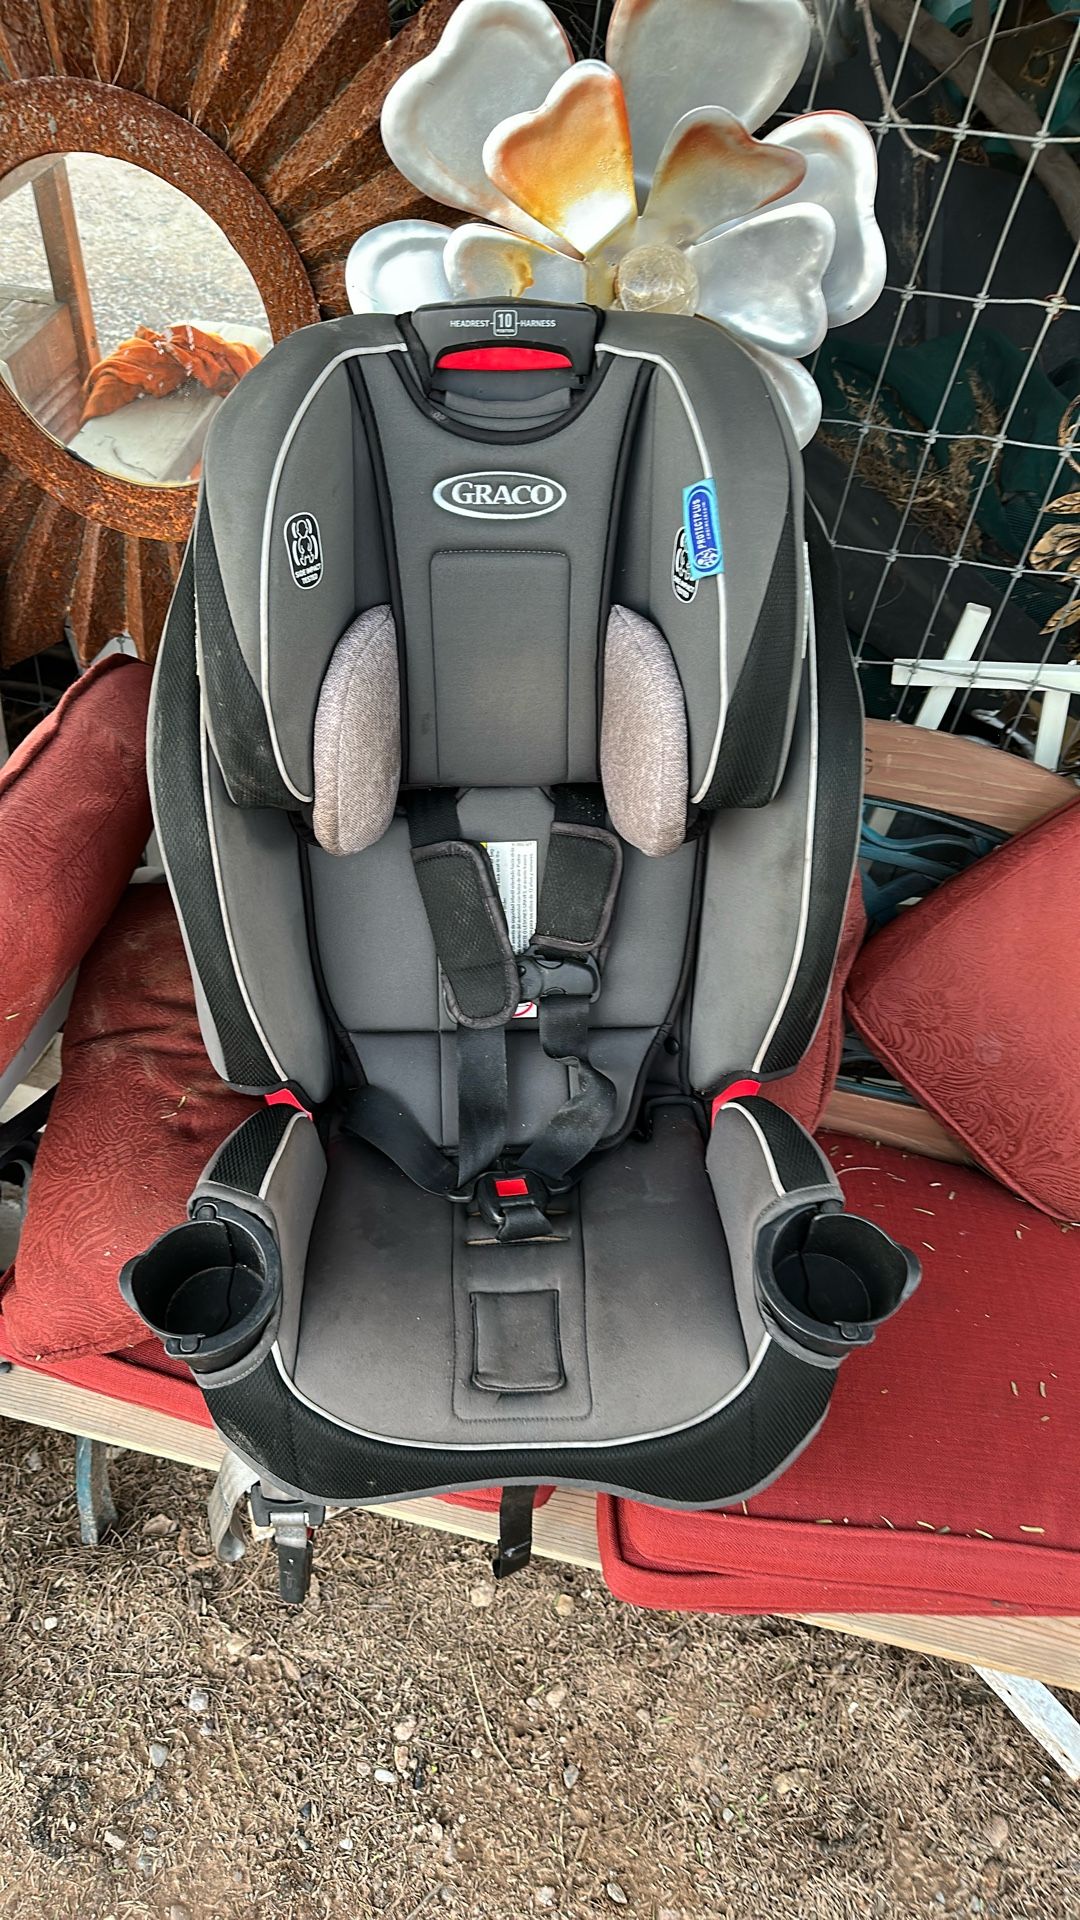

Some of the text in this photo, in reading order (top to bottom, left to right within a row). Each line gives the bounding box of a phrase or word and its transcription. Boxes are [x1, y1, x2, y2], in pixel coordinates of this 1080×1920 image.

[449, 313, 557, 328] HEADREST 10 HARNESS
[451, 481, 554, 505] GRACO
[306, 563, 321, 574] IMPACT
